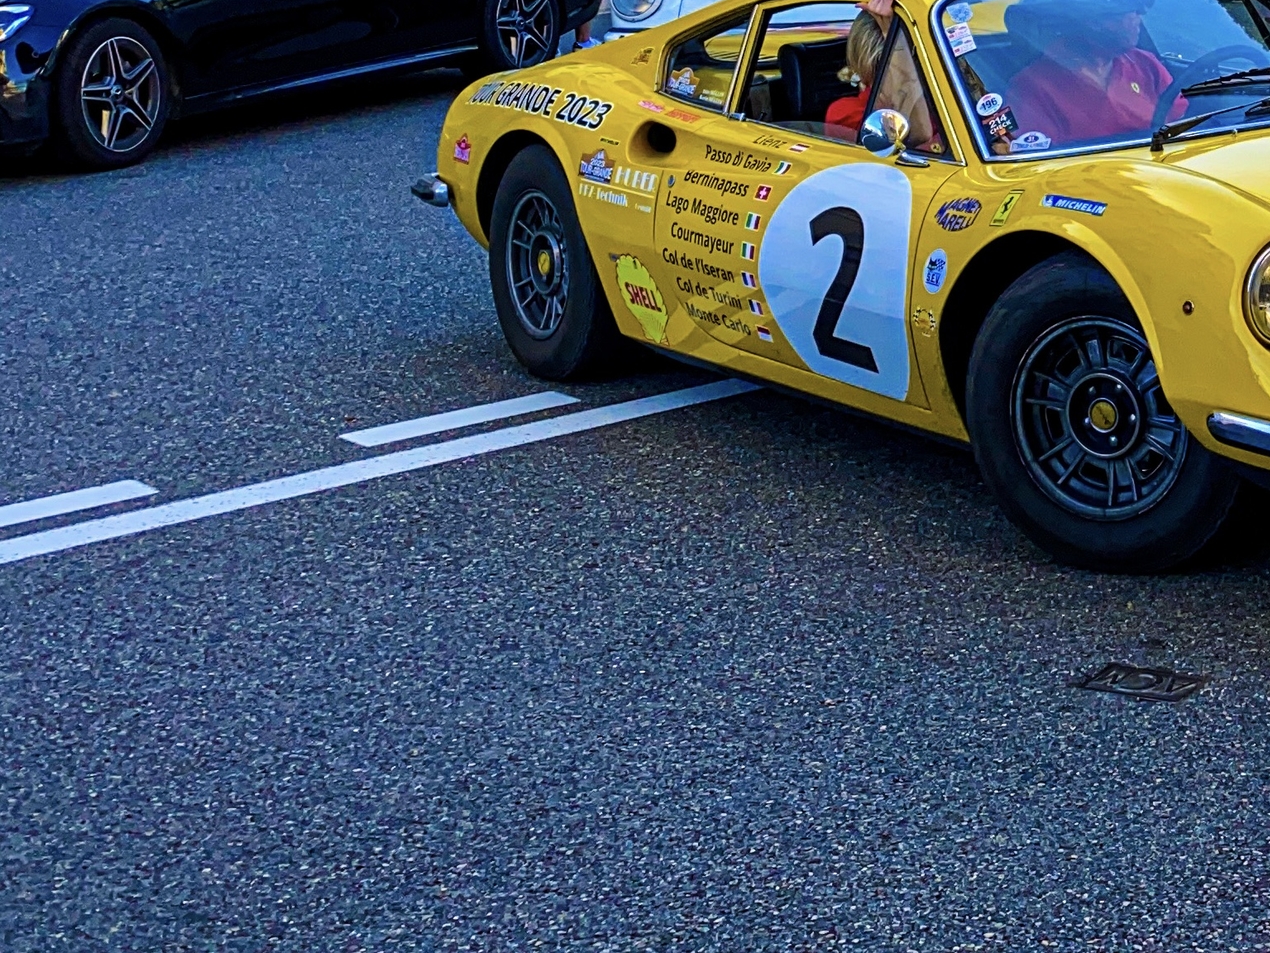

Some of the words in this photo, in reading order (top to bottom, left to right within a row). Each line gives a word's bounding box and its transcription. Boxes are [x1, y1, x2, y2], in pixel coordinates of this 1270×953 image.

[465, 82, 505, 106] TOUR
[495, 82, 562, 117] GRANDE
[555, 92, 614, 131] 2023
[988, 113, 1008, 129] 214
[752, 134, 787, 149] Lienz
[705, 144, 733, 165] Passo
[731, 150, 743, 170] di
[743, 153, 772, 173] Gavia
[683, 169, 750, 197] Berninapass
[665, 190, 689, 215] Lago
[691, 197, 740, 225] Maggiore
[1054, 198, 1106, 215] MICHELIN
[671, 221, 735, 255] Courmayeur
[662, 247, 678, 266] Col
[680, 252, 694, 271] de
[624, 281, 663, 313] SHELL
[676, 276, 694, 297] Col
[695, 281, 709, 299] de
[709, 288, 743, 310] Turini
[808, 205, 880, 375] 2
[684, 302, 722, 326] Monte
[721, 313, 752, 336] Carlo
